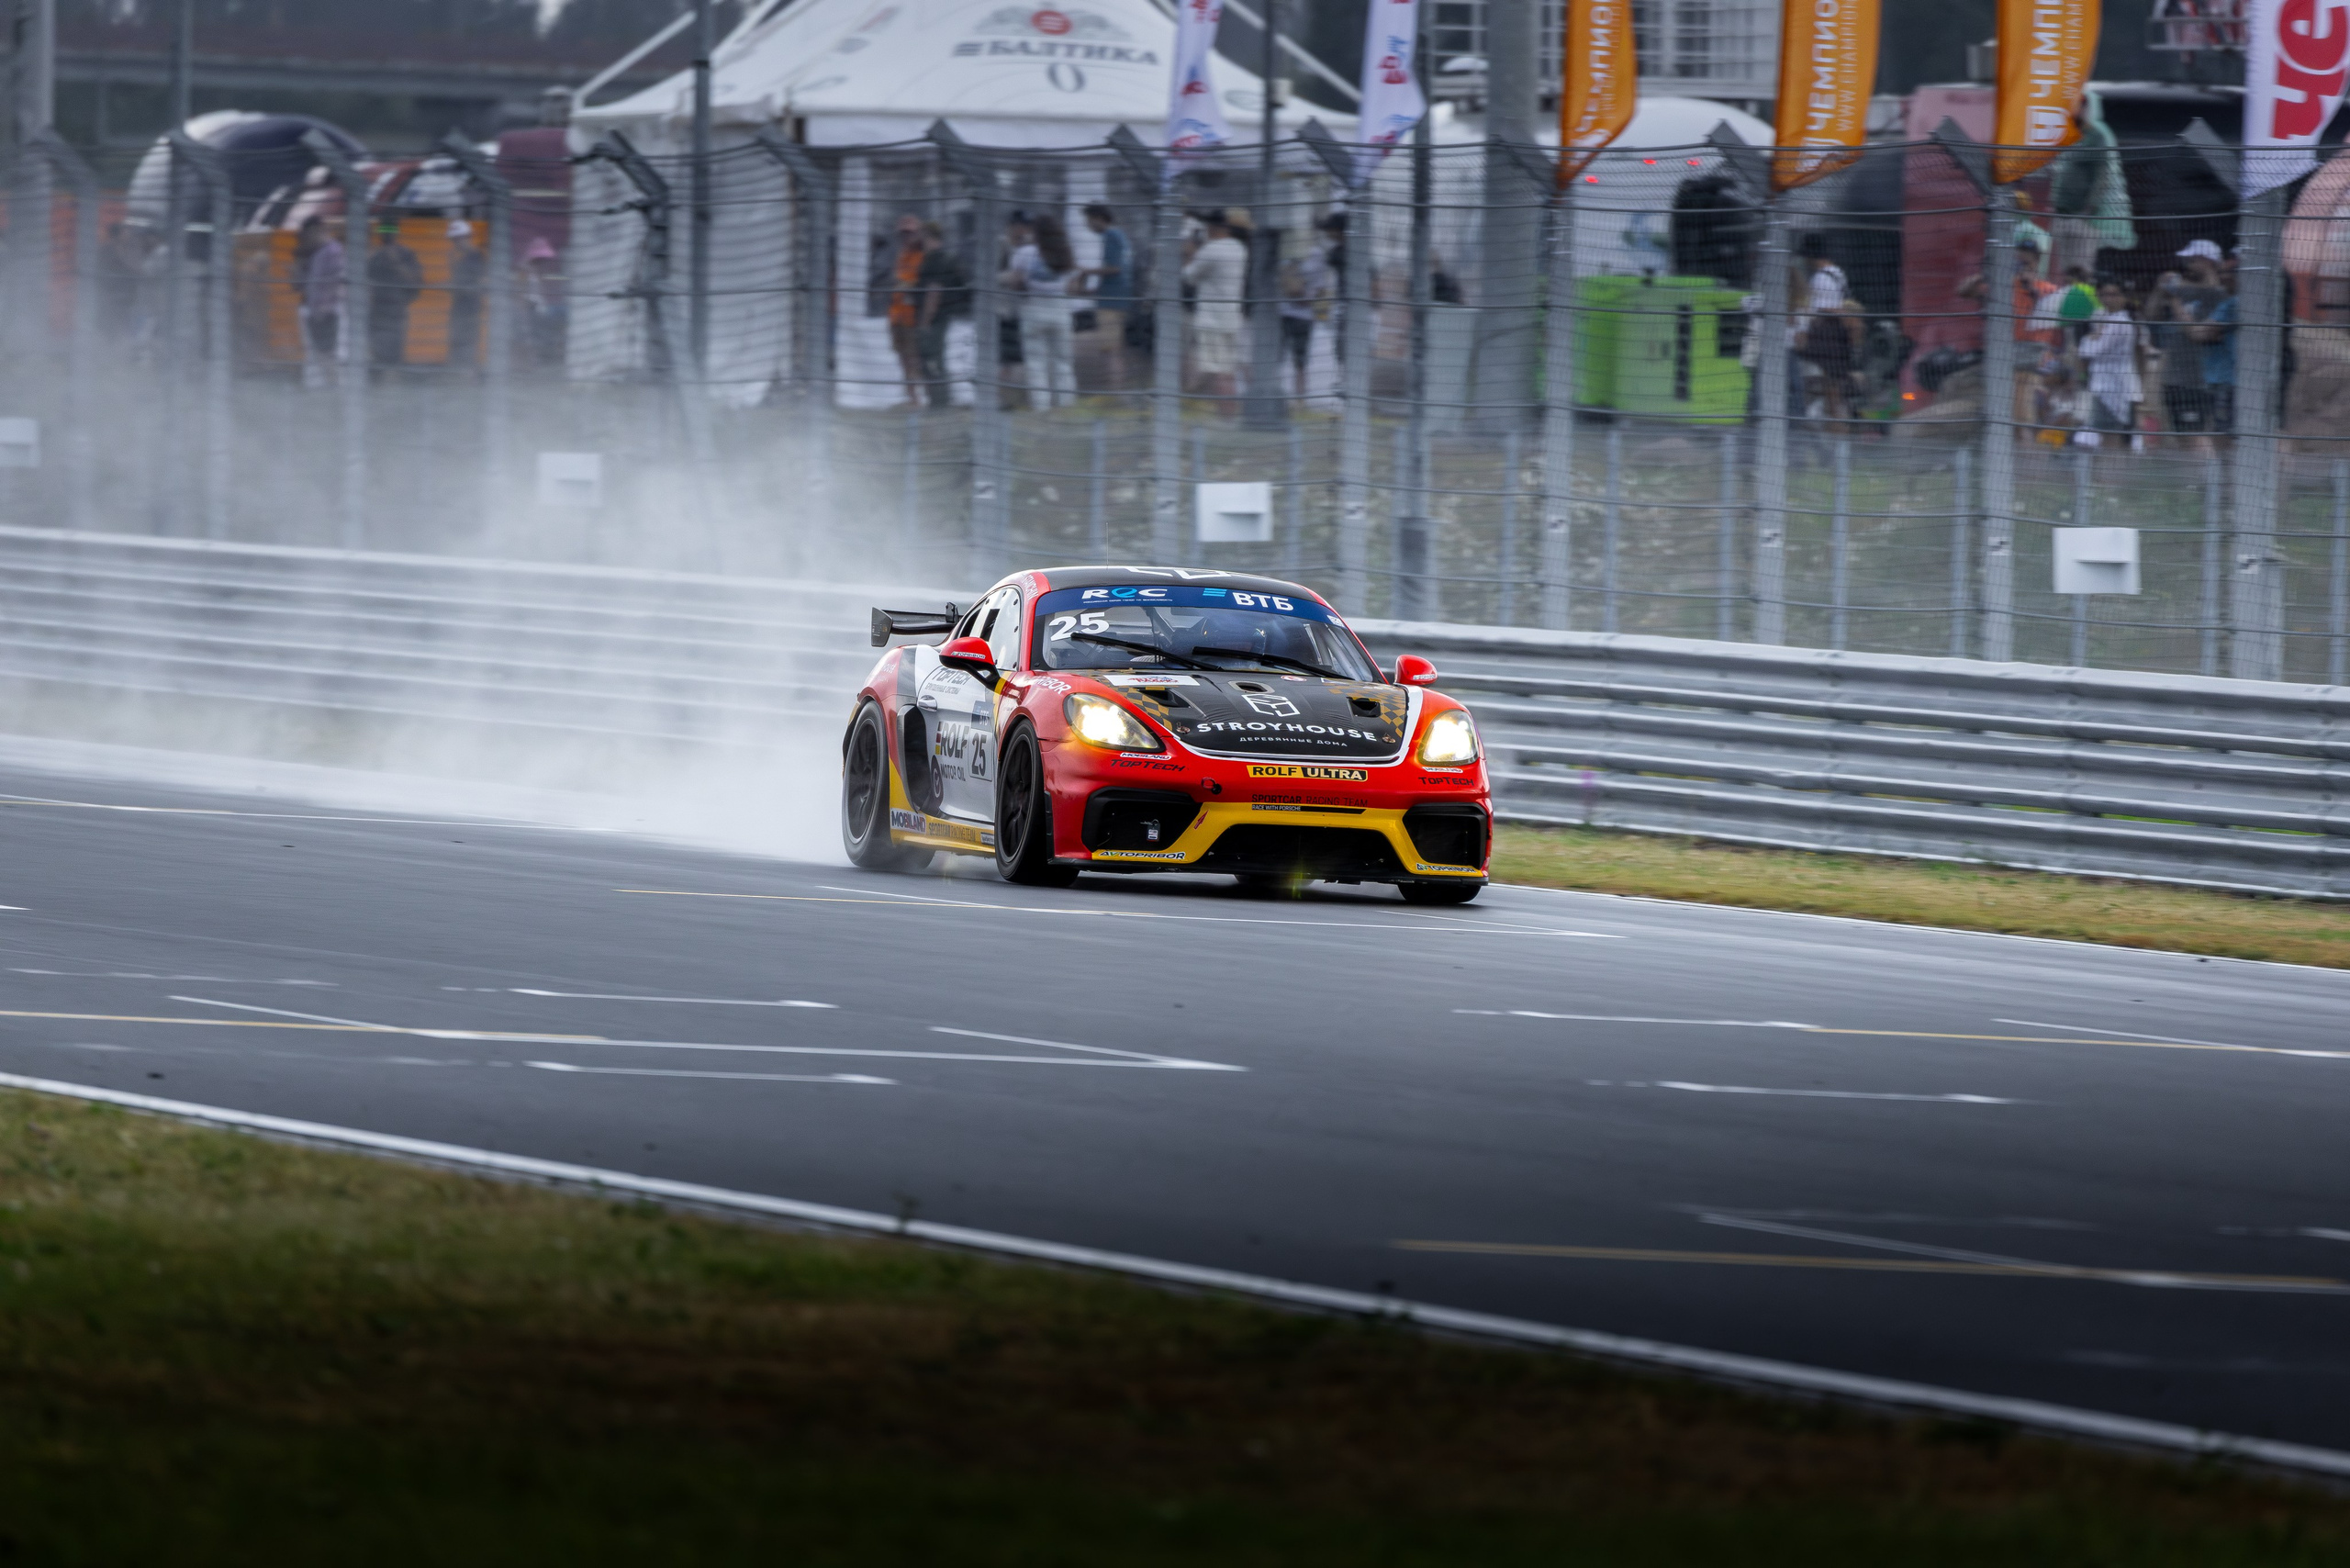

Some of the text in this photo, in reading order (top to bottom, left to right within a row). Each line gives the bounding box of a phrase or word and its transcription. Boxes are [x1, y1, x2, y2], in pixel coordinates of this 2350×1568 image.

[987, 40, 1159, 66] БАЛТИКА
[2029, 0, 2064, 97] ЧЕМП
[1574, 0, 1613, 131] ЧЕМПИО
[1232, 592, 1293, 611] ВТБ
[1048, 612, 1110, 642] 25
[940, 722, 969, 758] ROLF
[1197, 722, 1377, 742] STROYHOUSE
[1316, 739, 1348, 747] ДОМА
[971, 733, 987, 777] 25
[1252, 767, 1363, 780] ROLF ULTRA
[1251, 794, 1369, 807] SPORTCAR RACING TEAM
